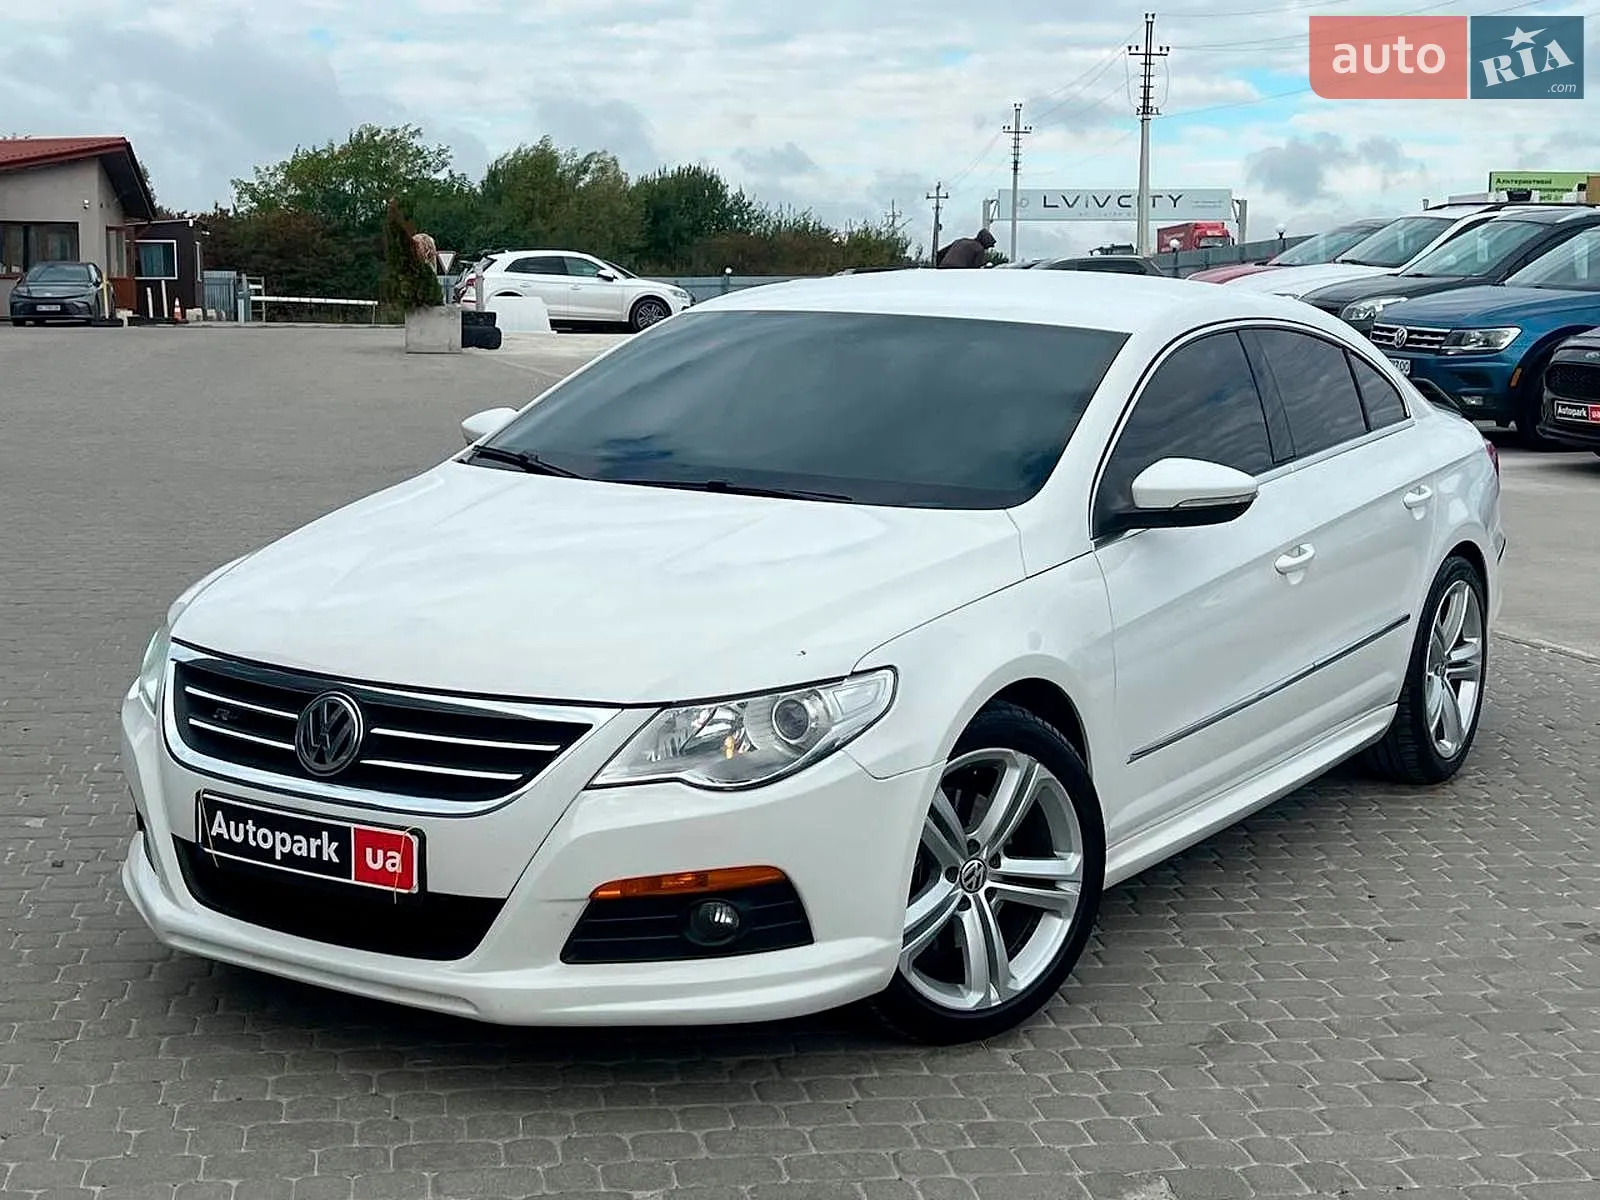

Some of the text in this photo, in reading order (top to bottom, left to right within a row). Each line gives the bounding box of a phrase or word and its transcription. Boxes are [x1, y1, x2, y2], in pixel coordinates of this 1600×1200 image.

[1557, 405, 1588, 418] Autopark
[210, 810, 402, 874] Autopark ua
